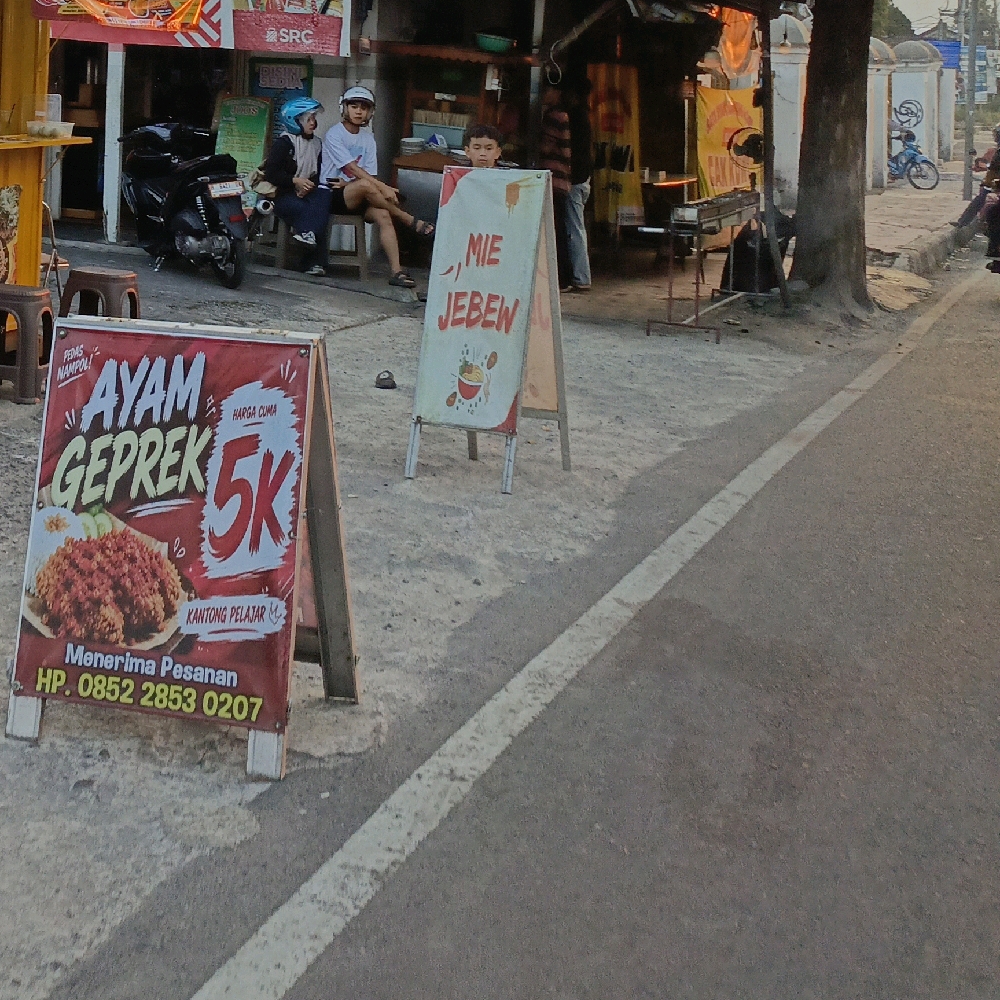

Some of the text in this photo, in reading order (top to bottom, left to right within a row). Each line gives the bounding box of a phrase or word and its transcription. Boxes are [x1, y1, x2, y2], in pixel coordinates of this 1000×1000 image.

[279, 27, 314, 44] SRC
[465, 233, 504, 268] MIE
[438, 290, 520, 335] JEBEW
[56, 353, 94, 381] NAMPOL!
[63, 343, 84, 362] PEDAS
[80, 351, 207, 432] AYAM
[231, 403, 278, 420] HARGA CUMA
[51, 424, 216, 512] GEPREK
[207, 433, 296, 563] 5K
[185, 604, 267, 626] KANTONG PELAJAR
[64, 643, 238, 688] Menerima Pesanan
[35, 668, 263, 723] HP. 0852 2853 0207
